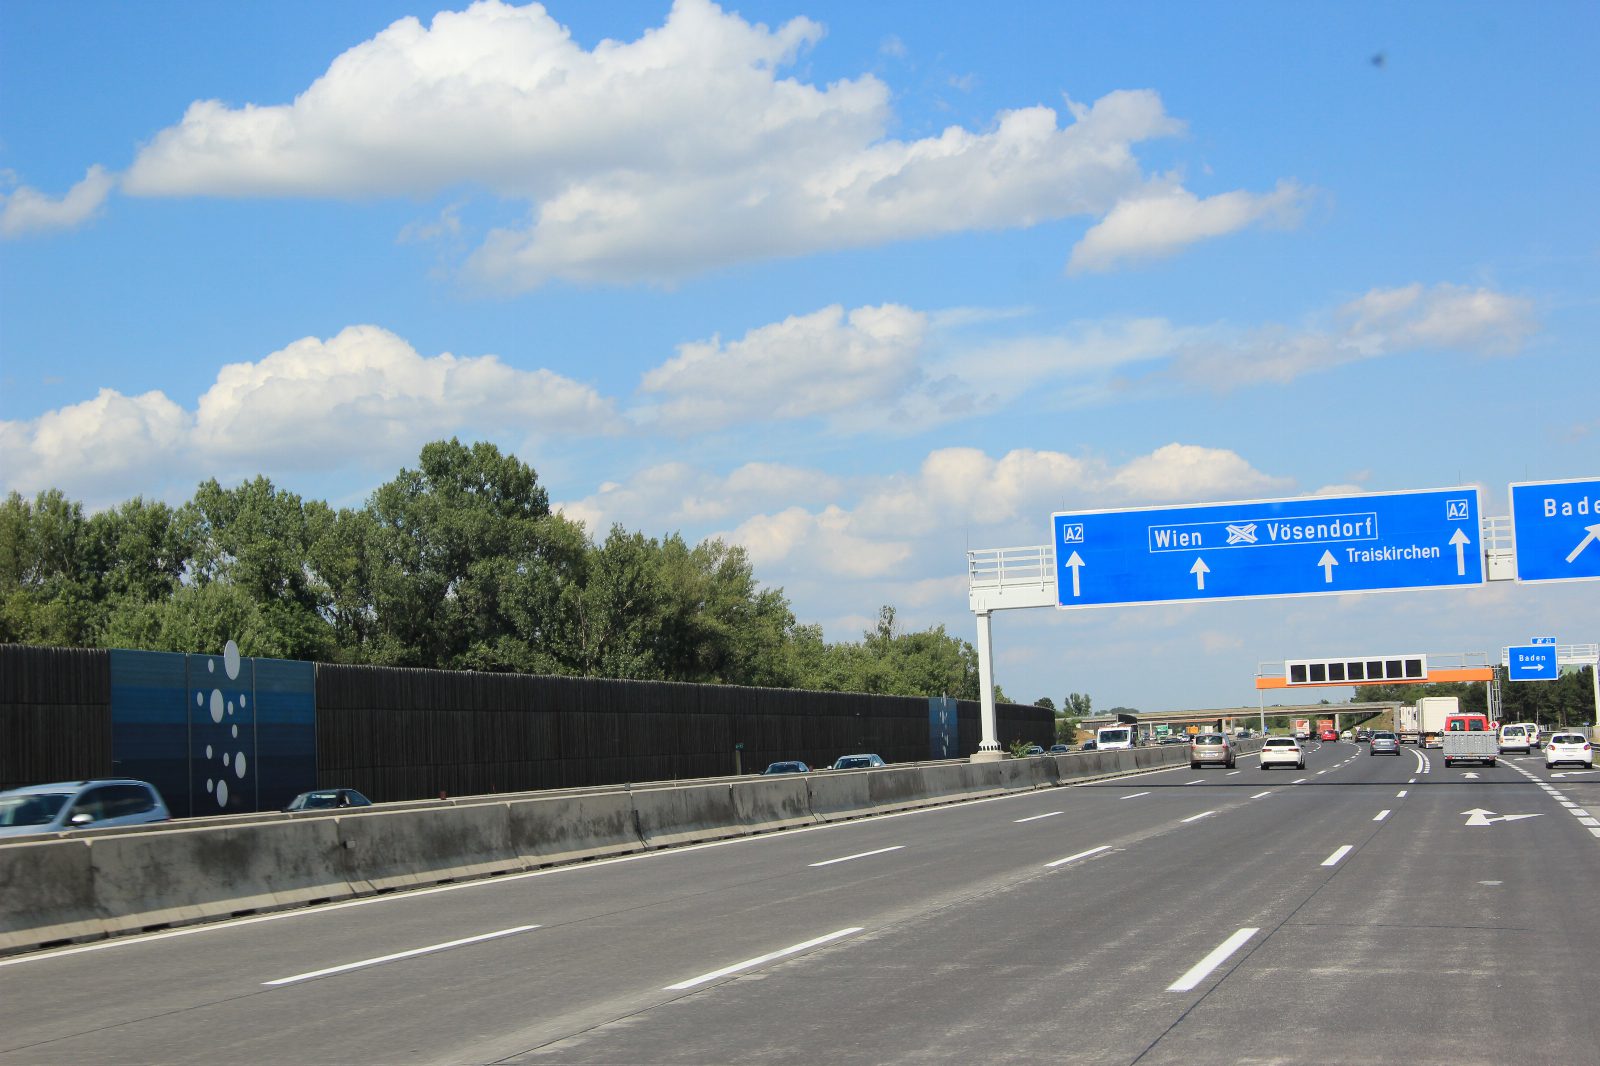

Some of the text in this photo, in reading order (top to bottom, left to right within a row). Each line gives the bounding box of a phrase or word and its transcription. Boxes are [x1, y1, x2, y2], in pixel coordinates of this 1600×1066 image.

[1449, 502, 1467, 518] A2
[1065, 526, 1082, 541] A2
[1154, 517, 1372, 548] Wien Vösendorf
[1346, 545, 1440, 563] Traiskirchen
[1518, 654, 1546, 662] Baden
